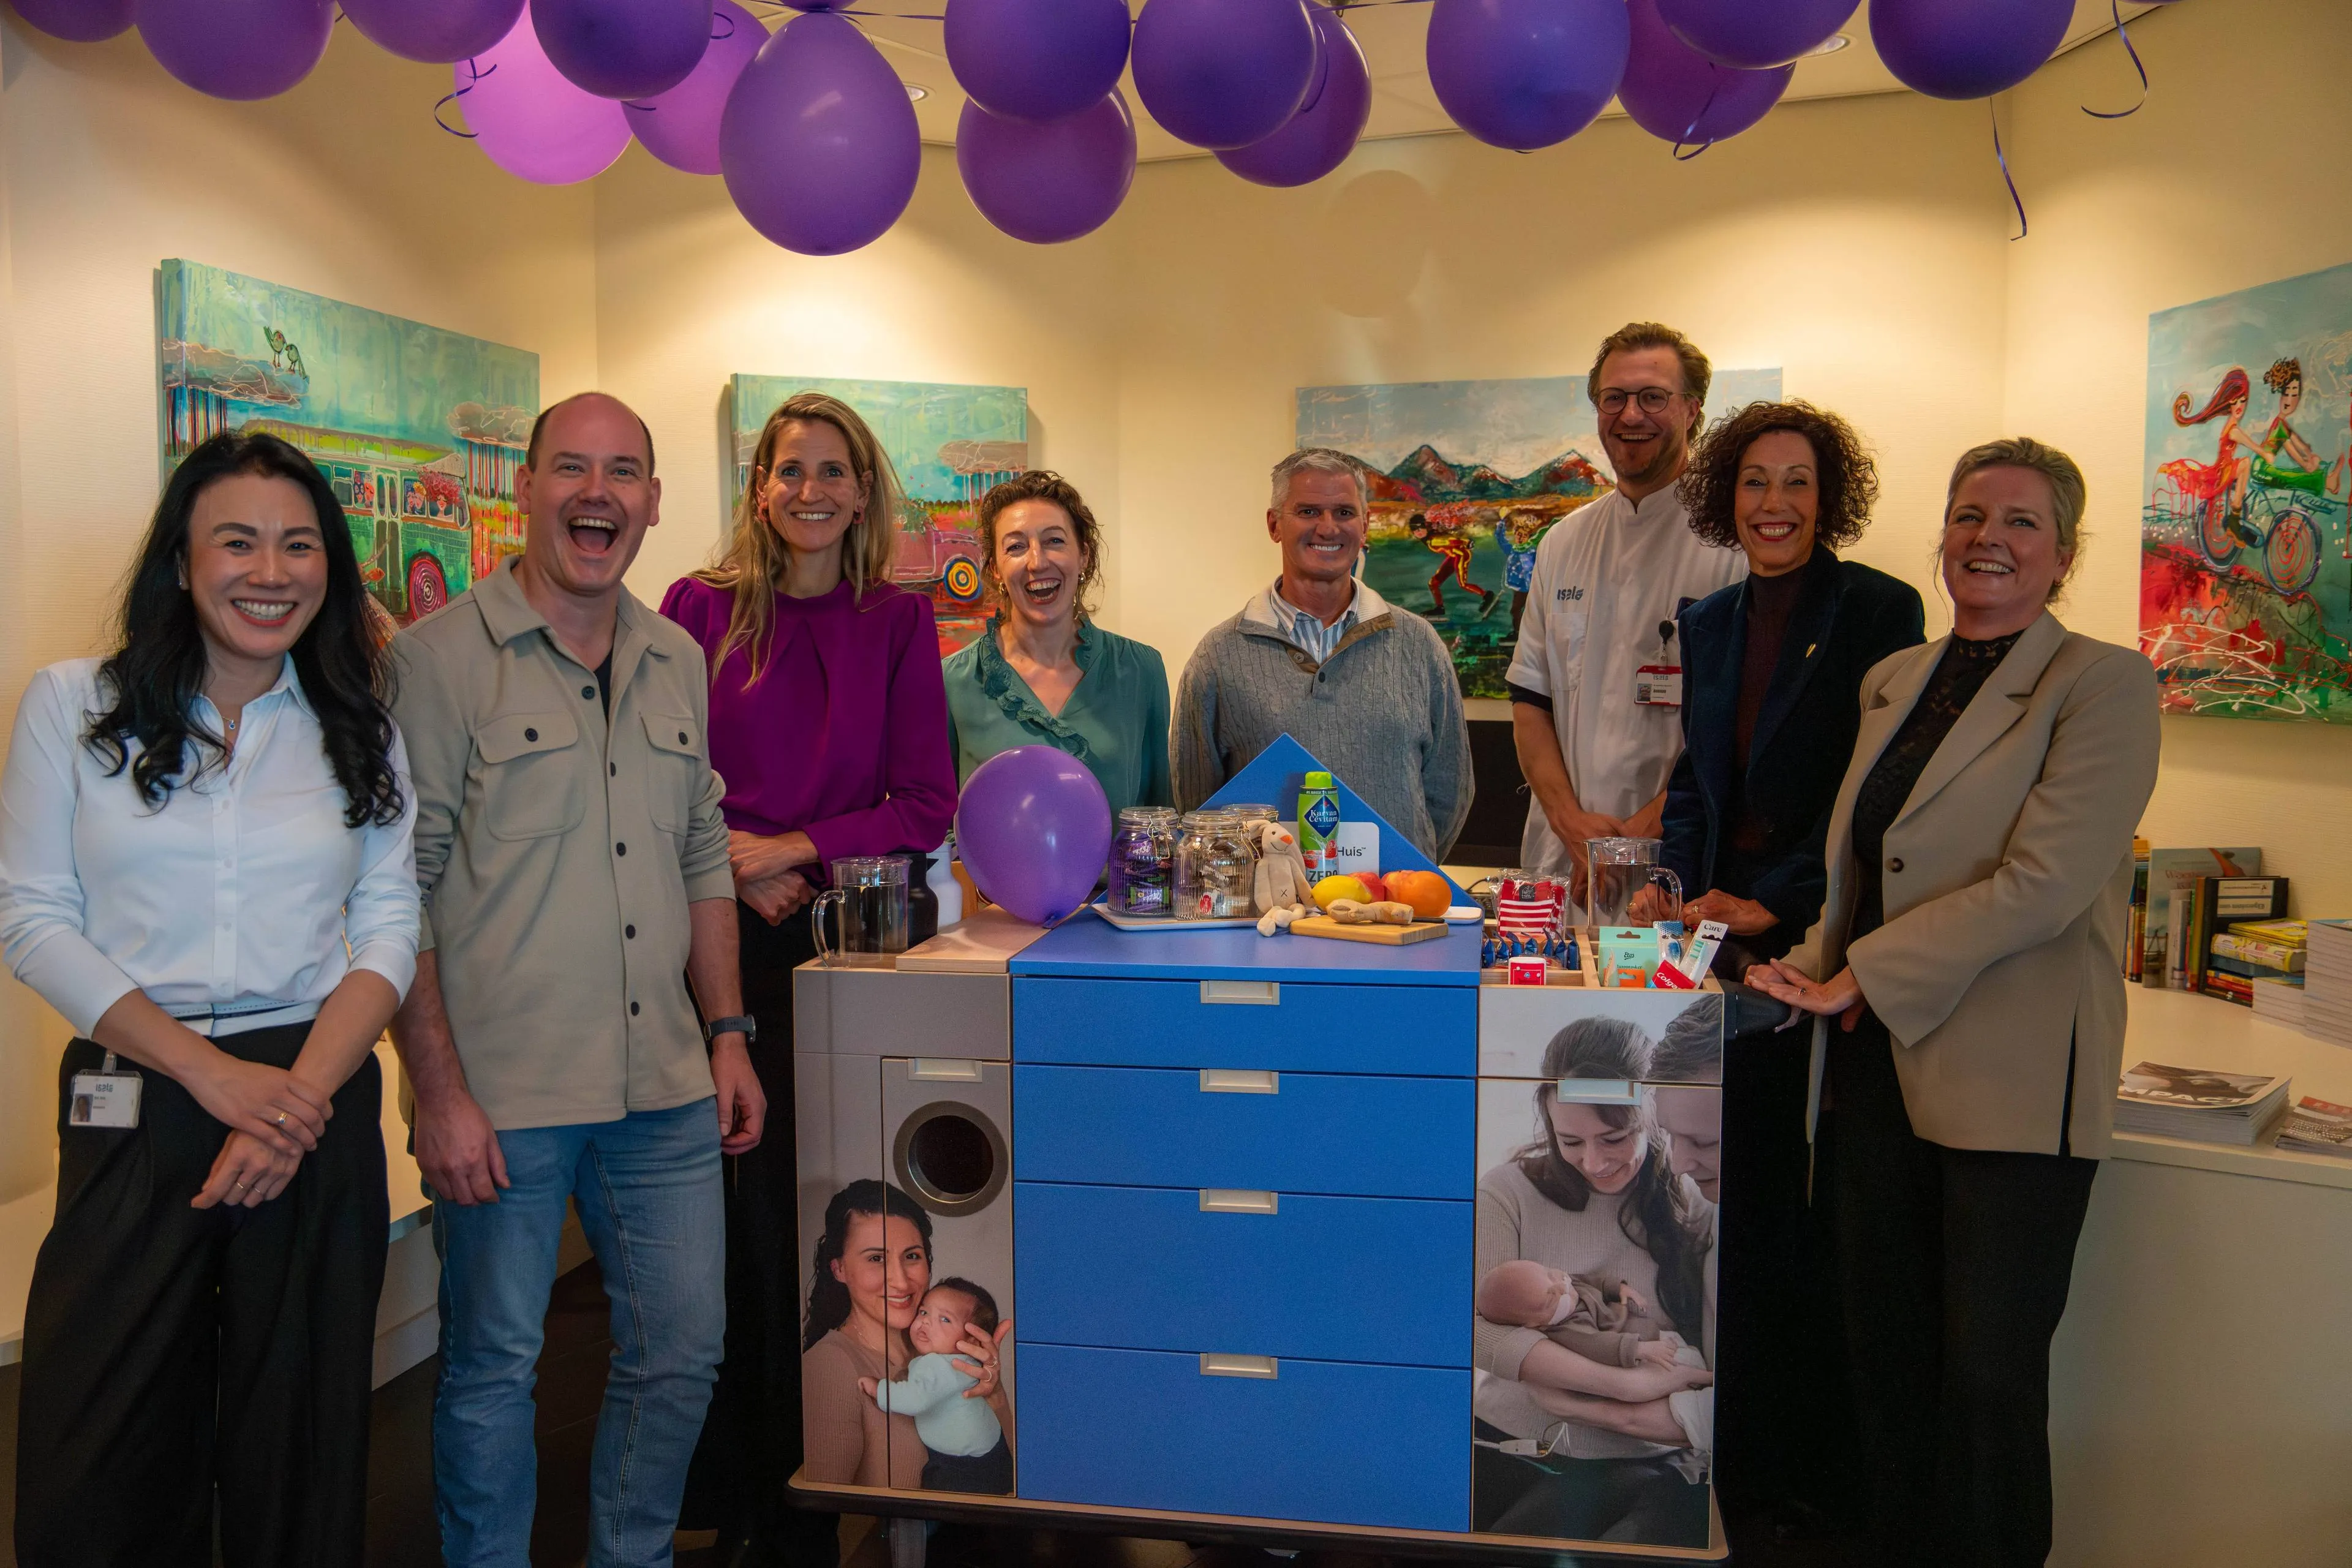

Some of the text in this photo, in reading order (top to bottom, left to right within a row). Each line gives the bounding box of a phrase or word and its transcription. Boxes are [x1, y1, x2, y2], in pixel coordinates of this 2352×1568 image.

[1704, 923, 1722, 932] Care
[1624, 951, 1635, 960] Etos
[1656, 972, 1679, 989] Colga
